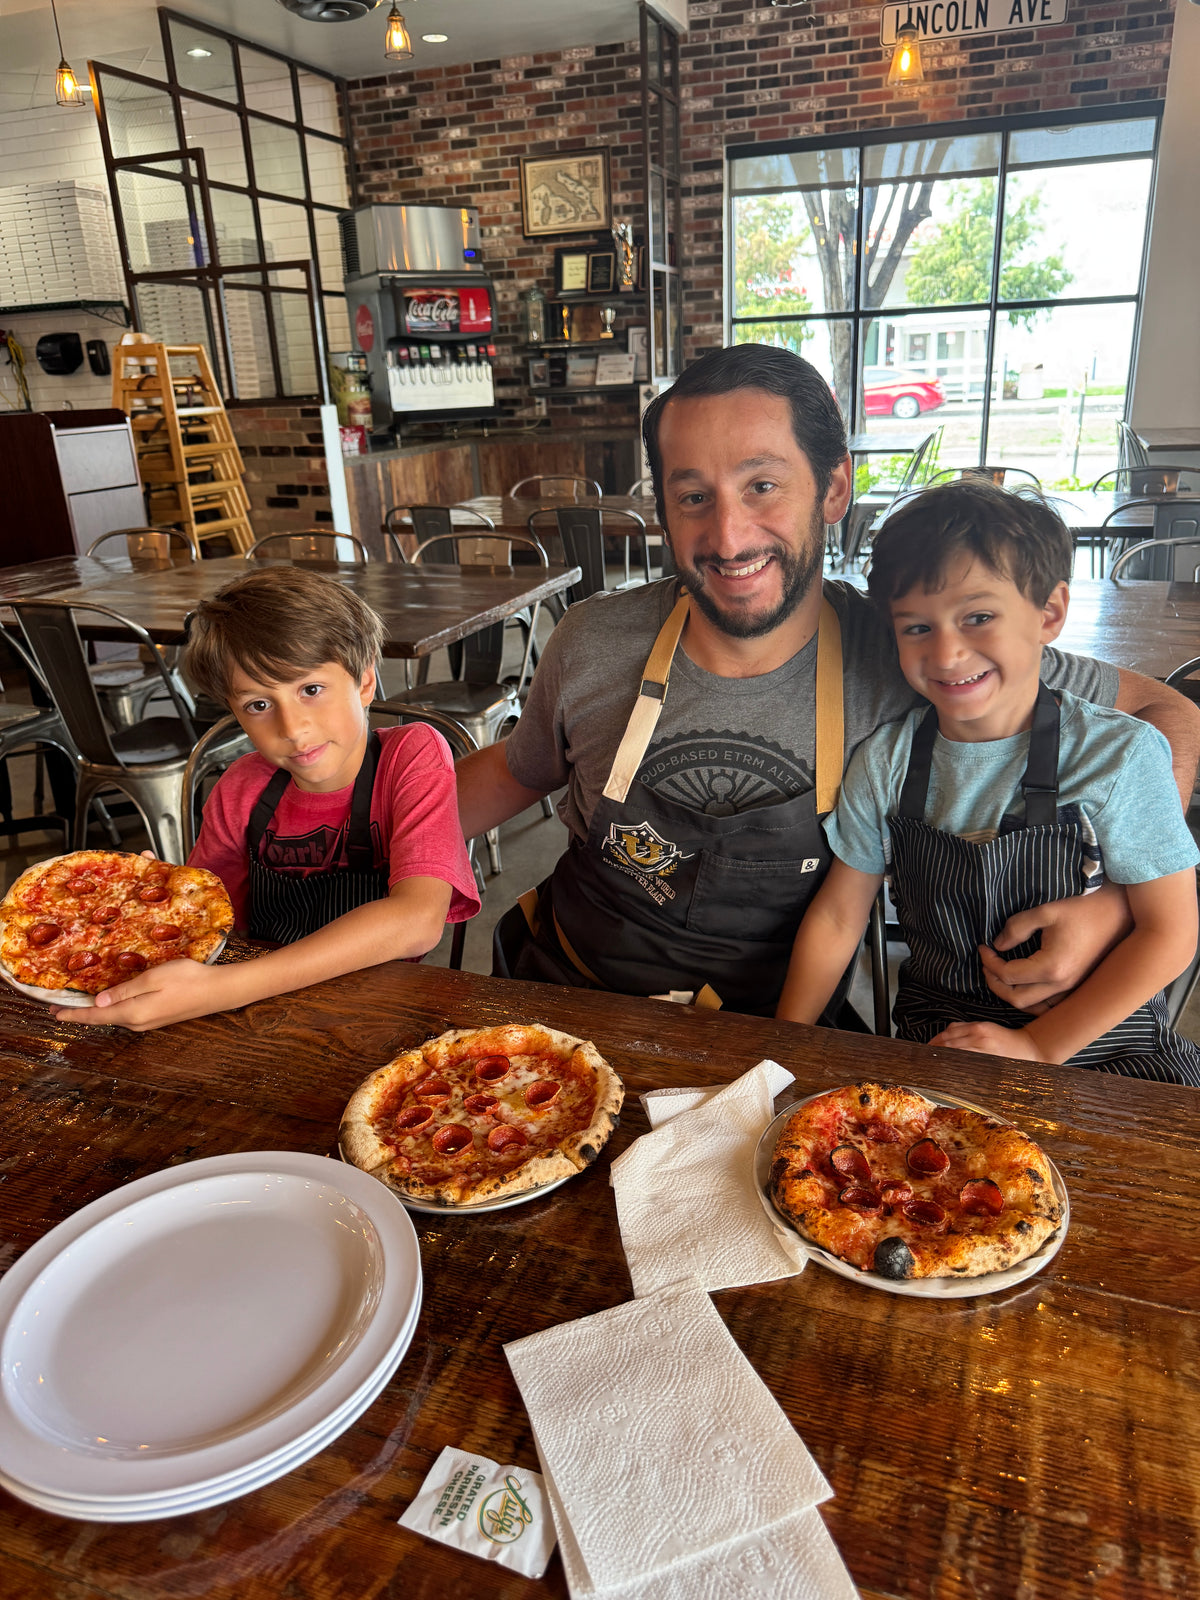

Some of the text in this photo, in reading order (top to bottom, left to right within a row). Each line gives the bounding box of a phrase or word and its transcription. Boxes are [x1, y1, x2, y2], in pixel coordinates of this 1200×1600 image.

[895, 0, 1052, 40] LINCOLN AVE
[640, 749, 805, 792] OUD-BASED ETRM ALTE
[433, 1471, 463, 1516] CHEESE
[439, 1464, 480, 1527] PARMESAN
[456, 1474, 486, 1522] GRATED
